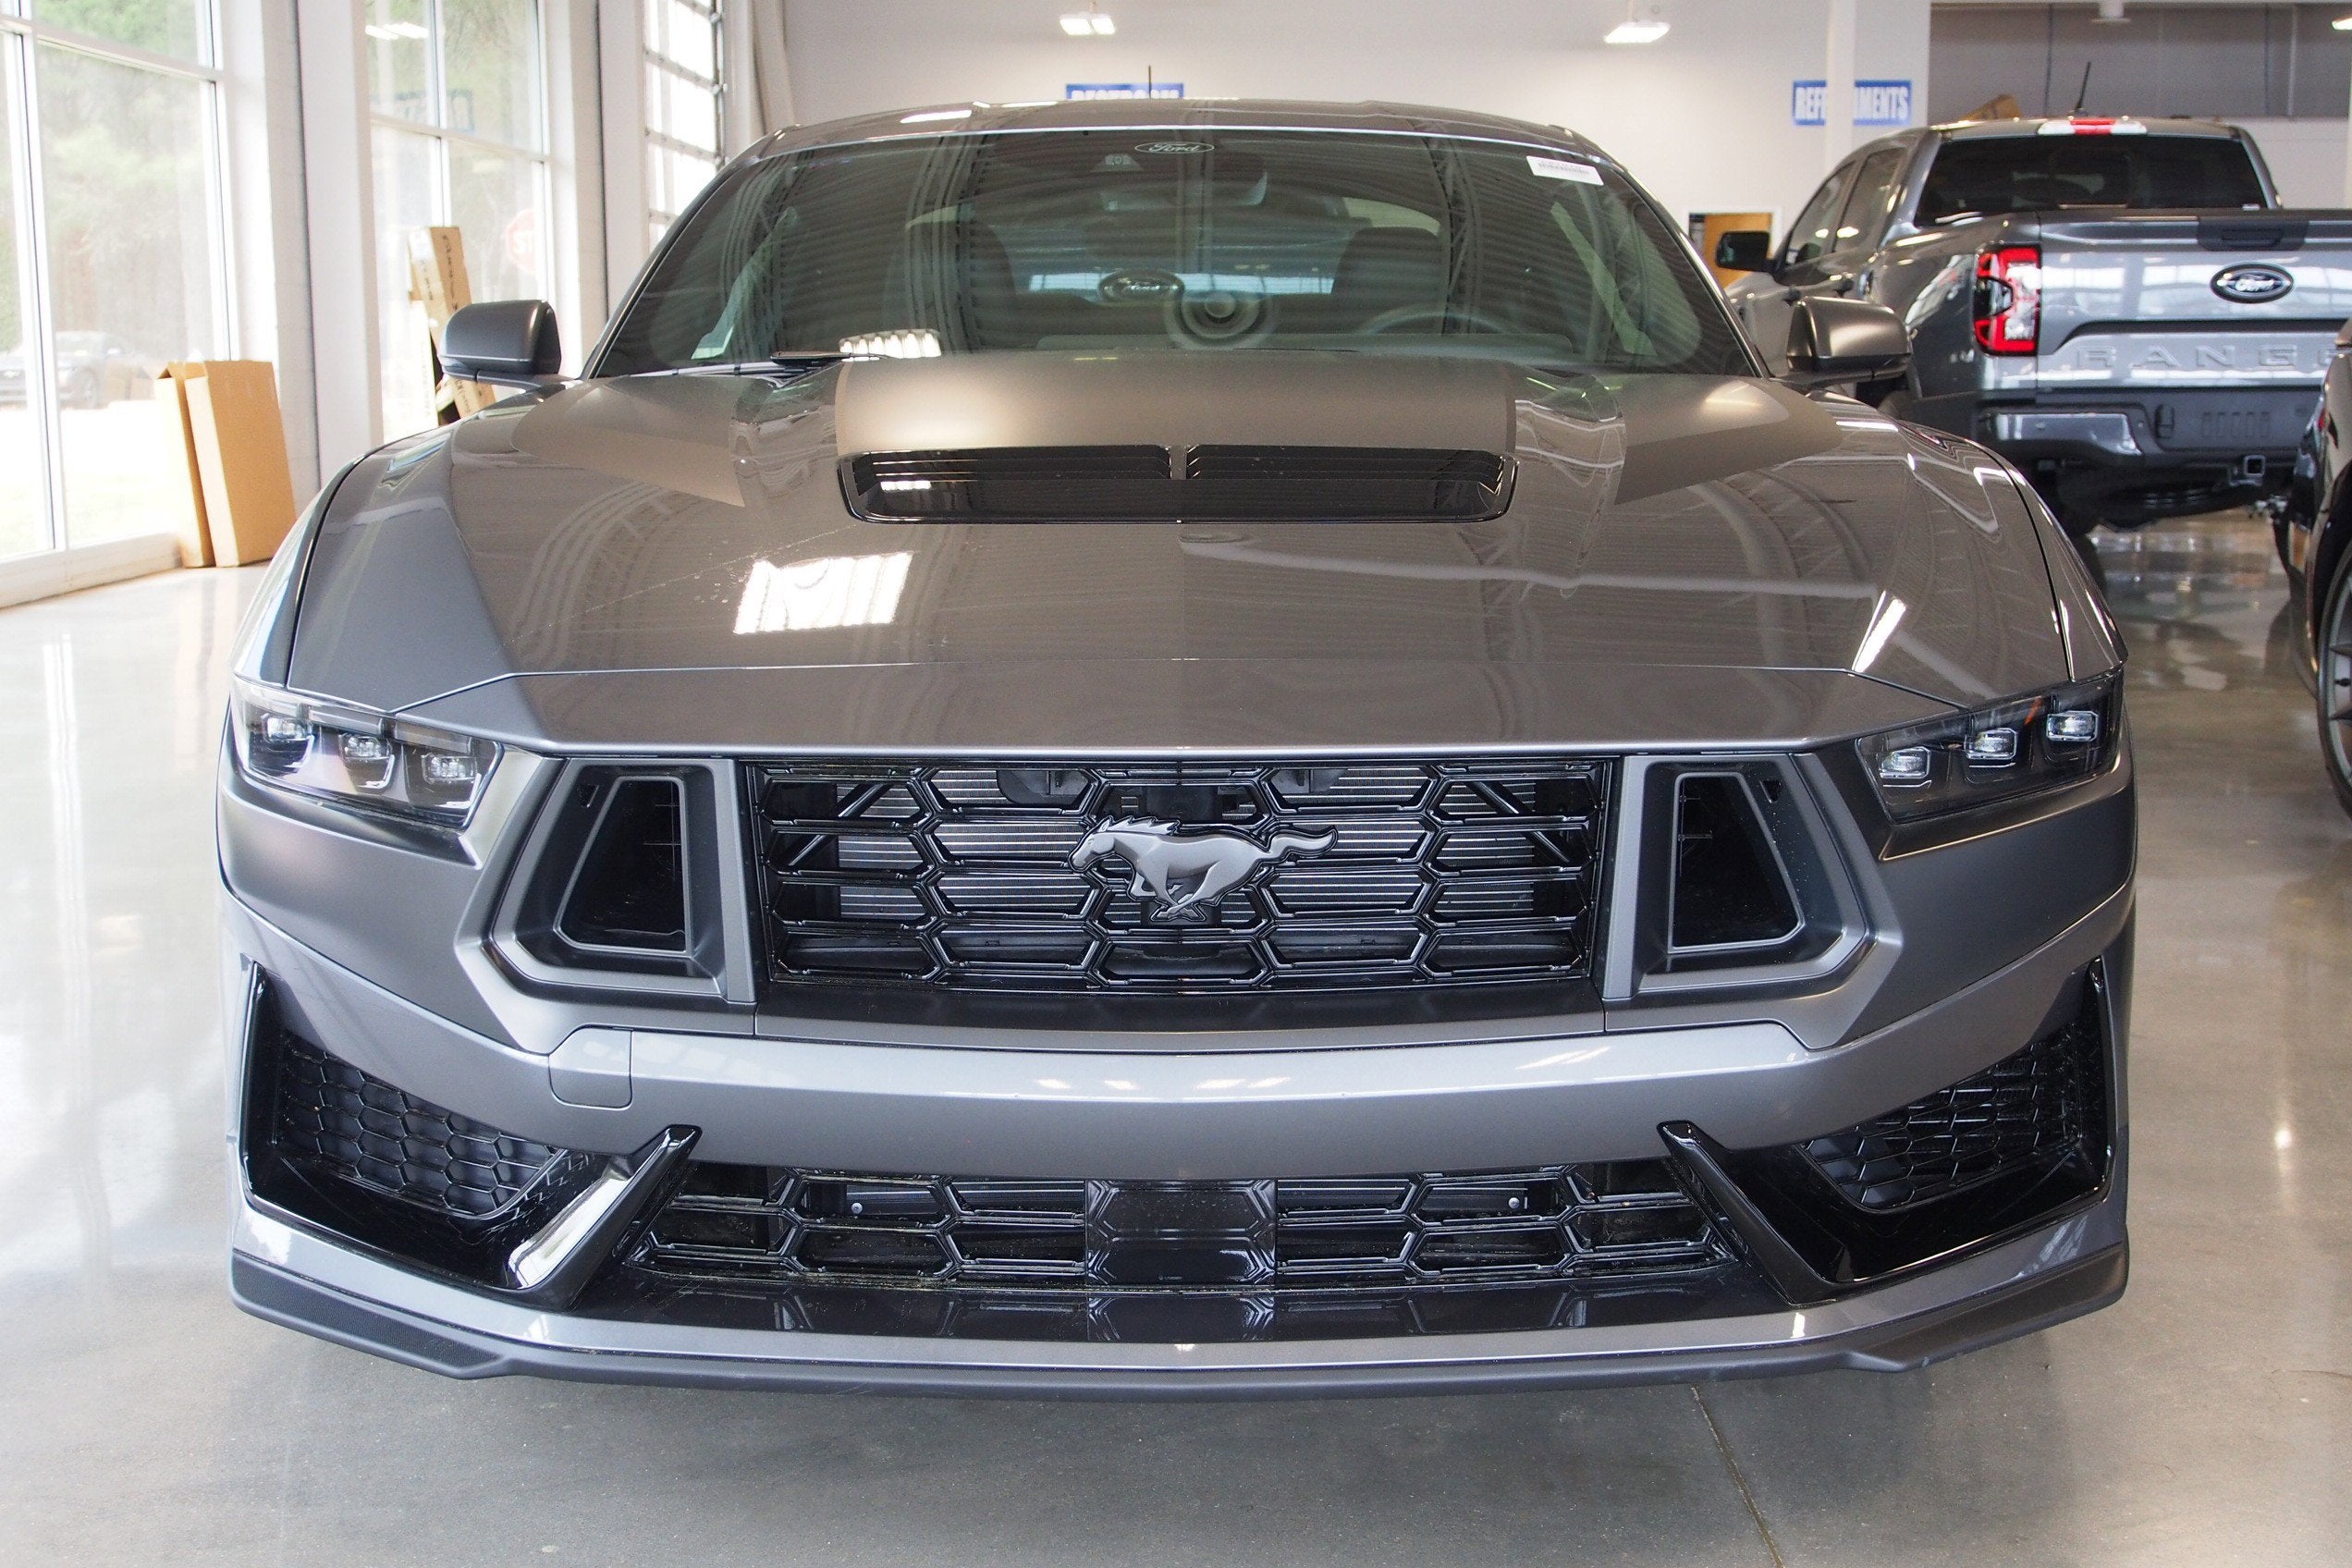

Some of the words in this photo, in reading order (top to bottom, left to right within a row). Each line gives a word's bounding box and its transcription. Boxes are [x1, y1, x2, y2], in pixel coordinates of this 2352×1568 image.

[1795, 87, 1908, 120] REFMENTS
[1147, 141, 1201, 153] Ford
[2076, 345, 2335, 368] RANG
